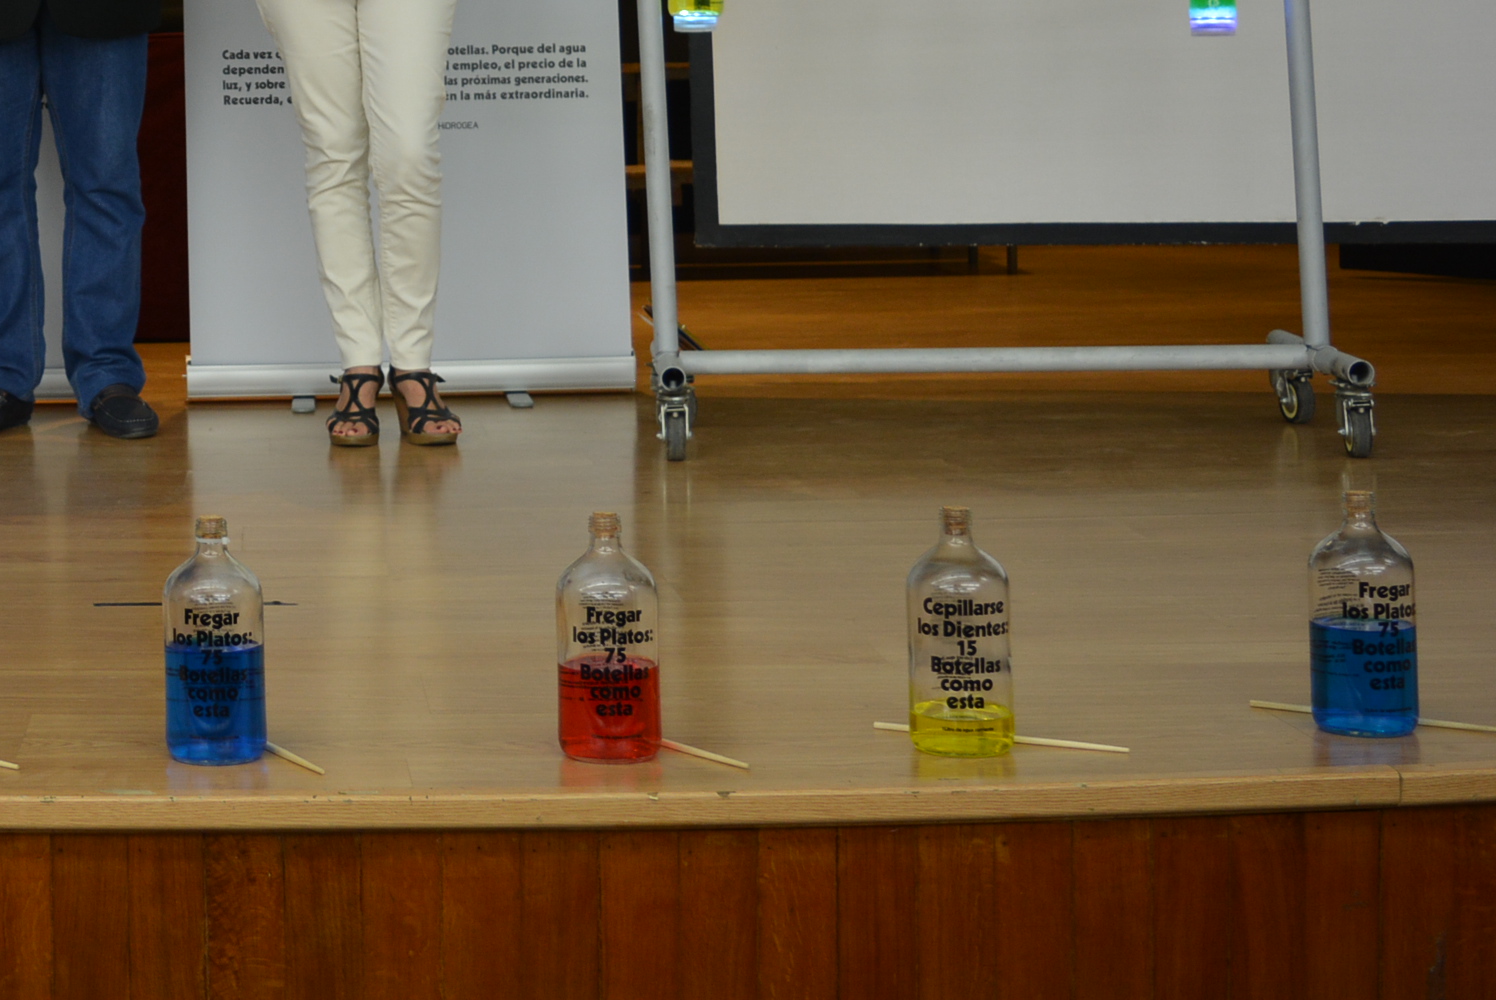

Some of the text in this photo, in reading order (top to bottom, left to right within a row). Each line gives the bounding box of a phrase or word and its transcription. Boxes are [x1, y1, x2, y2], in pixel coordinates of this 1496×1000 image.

[222, 43, 585, 60] Cada vez Porque del agua
[223, 58, 586, 76] dependen empleo, el precio de la
[223, 73, 588, 91] luz, y sobre las próximas generaciones.
[223, 88, 589, 106] Recuerda, la más extraordinaria.
[1359, 581, 1410, 600] Fregar
[586, 606, 642, 627] Fregar
[923, 598, 1004, 619] Cepillarse
[1342, 602, 1369, 619] los
[184, 608, 239, 629] Fregar
[573, 626, 653, 645] los Platos:
[918, 617, 1008, 638] los Dientes:
[1377, 622, 1399, 637] 75
[173, 628, 252, 647] los Platos:
[605, 648, 626, 663] 75
[957, 640, 977, 656] 15
[202, 651, 223, 665] 75
[931, 656, 1001, 674] Botellas
[1364, 658, 1411, 673] como
[179, 664, 247, 683] Botellas
[580, 663, 649, 682] Botellas
[941, 678, 993, 692] como
[1369, 676, 1404, 690] esta
[188, 687, 238, 701] como
[590, 685, 642, 699] como
[596, 702, 633, 716] esta
[946, 695, 984, 709] esta
[193, 704, 230, 718] esta
